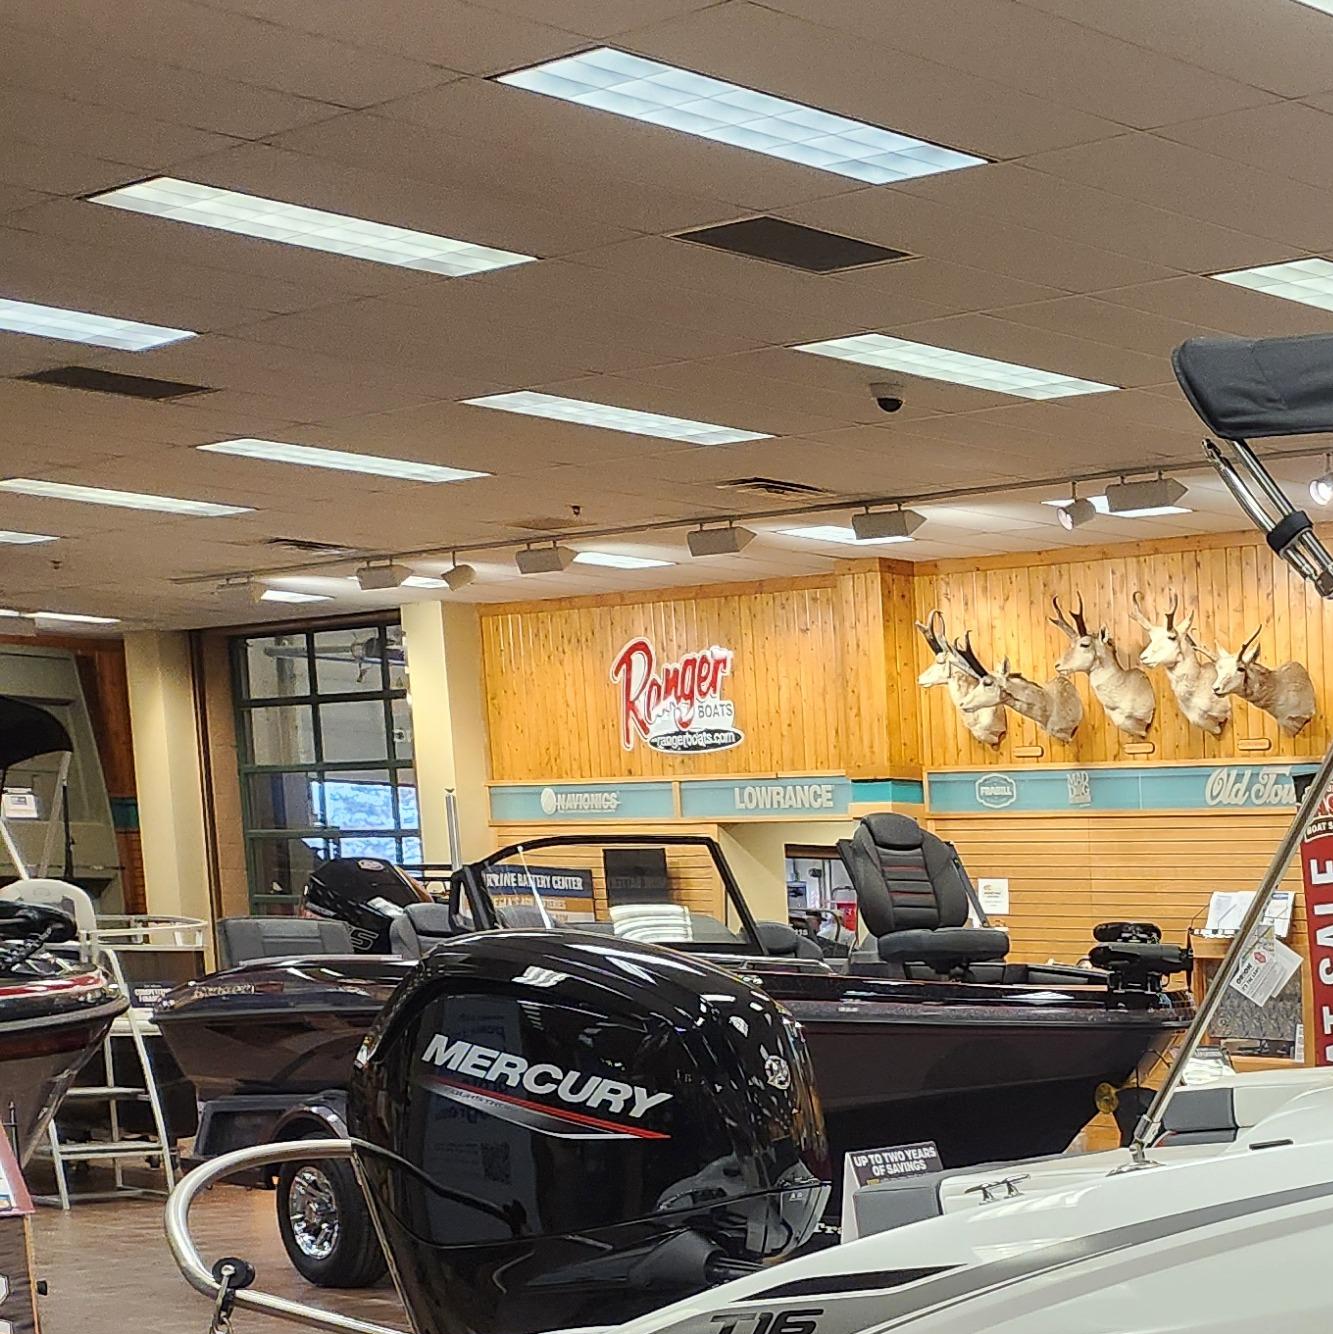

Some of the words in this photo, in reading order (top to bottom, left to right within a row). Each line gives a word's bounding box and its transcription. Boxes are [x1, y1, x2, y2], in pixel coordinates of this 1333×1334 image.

[613, 640, 728, 745] Ranger
[697, 703, 733, 719] BOATS
[1206, 767, 1251, 806] Old
[557, 792, 620, 808] NAVIONICS
[734, 785, 834, 809] LOWRANCE
[1306, 822, 1327, 834] BOAT
[551, 875, 584, 890] CENTER
[421, 1033, 674, 1119] MERCURY
[853, 1156, 869, 1167] UP
[868, 1154, 882, 1165] TO
[882, 1151, 906, 1163] TWO
[905, 1147, 937, 1161] YEARS
[872, 1165, 886, 1177] OF
[886, 1160, 928, 1175] SAVINGS
